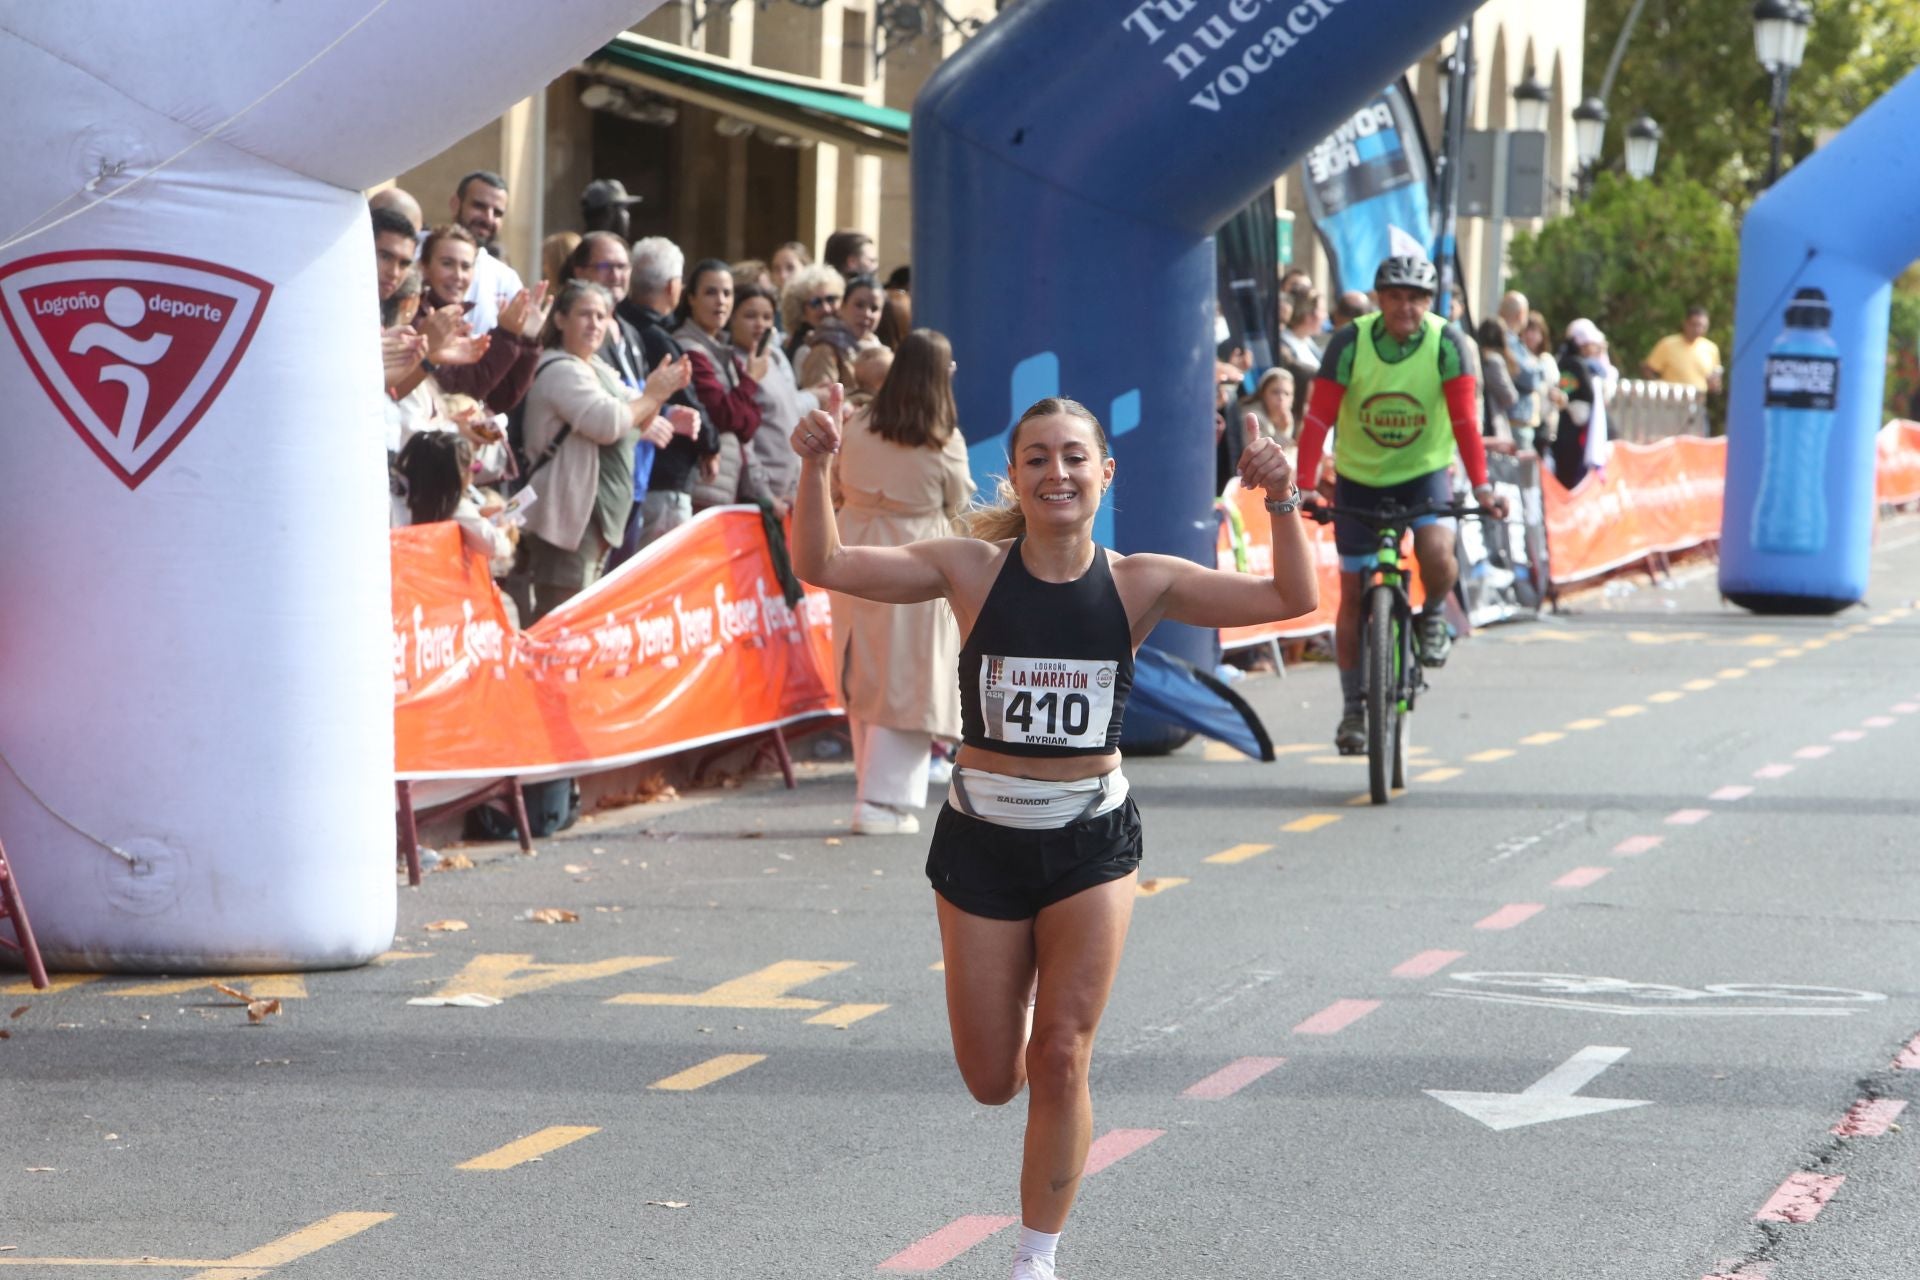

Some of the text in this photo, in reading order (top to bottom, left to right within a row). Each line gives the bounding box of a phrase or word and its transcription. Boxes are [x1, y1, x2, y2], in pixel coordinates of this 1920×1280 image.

[1162, 0, 1271, 81] nue
[1189, 0, 1347, 112] vocaci
[33, 291, 222, 323] Logroño deporte
[1034, 662, 1067, 671] LOGROÑO
[1012, 670, 1089, 689] LA MARATÓN
[1005, 690, 1090, 736] 410
[1025, 735, 1068, 745] MYRIAM
[997, 796, 1050, 806] SALOMON
